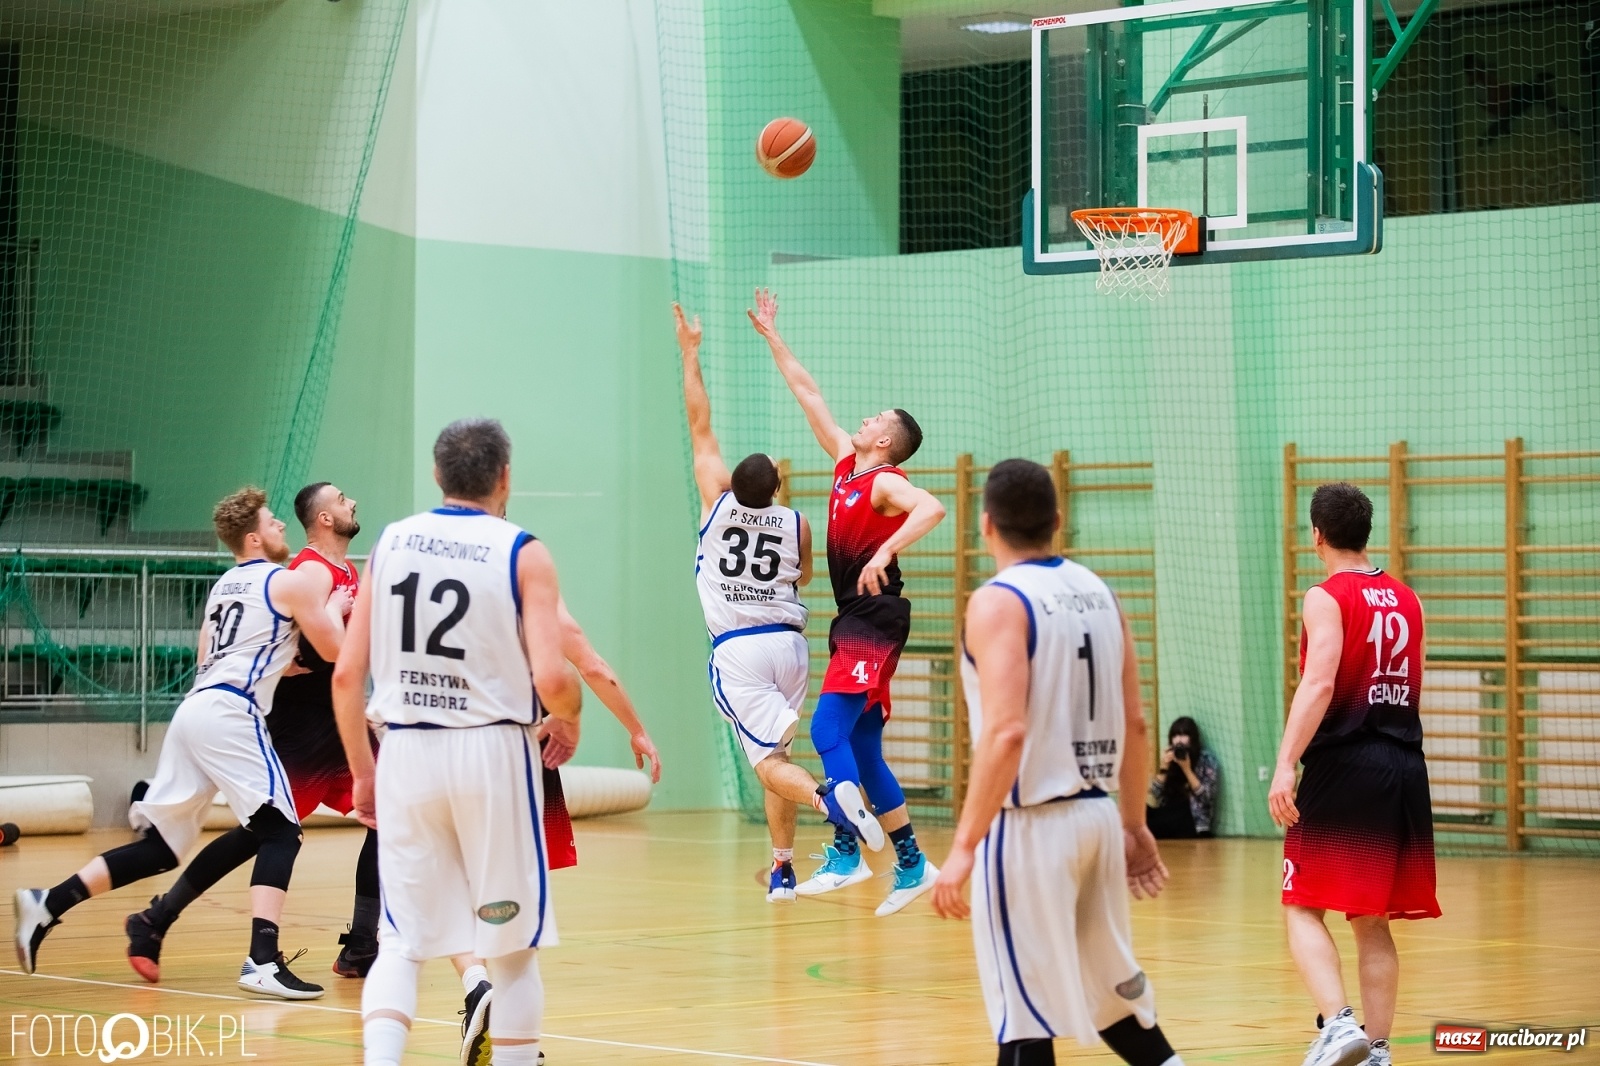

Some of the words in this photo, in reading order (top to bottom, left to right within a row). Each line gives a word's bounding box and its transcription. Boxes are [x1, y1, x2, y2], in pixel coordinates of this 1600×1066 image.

[729, 508, 738, 522] P.
[741, 512, 784, 529] SZKLARZ
[405, 534, 491, 563] ATŁACHOWICZ
[718, 526, 784, 582] 35
[209, 601, 245, 653] 10
[390, 571, 471, 661] 12
[1366, 610, 1410, 679] 12
[400, 670, 471, 691] FENSYWA
[851, 660, 869, 685] 4
[1077, 632, 1095, 722] 1
[403, 690, 469, 711] ACIBÓRZ
